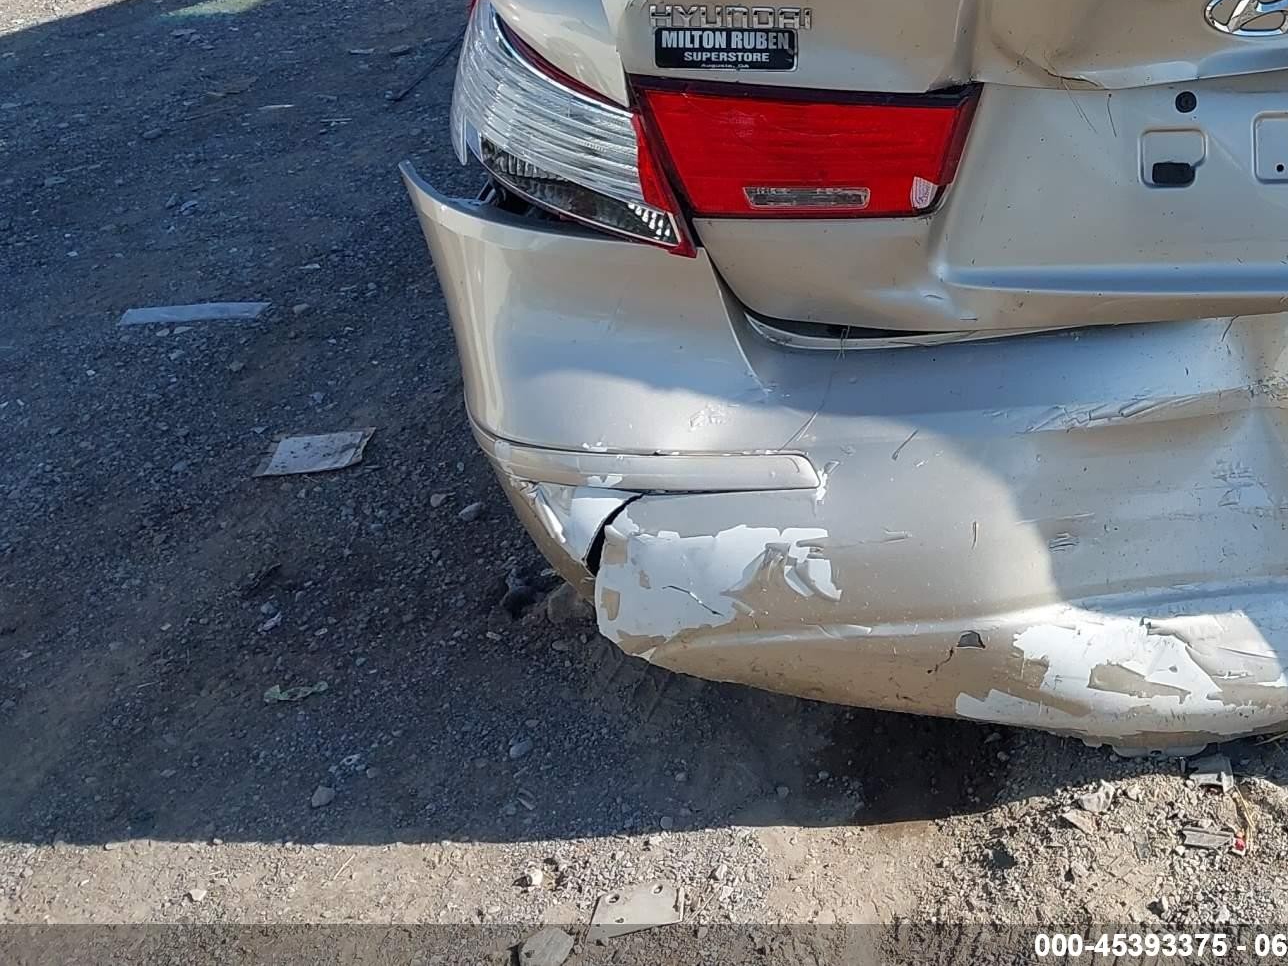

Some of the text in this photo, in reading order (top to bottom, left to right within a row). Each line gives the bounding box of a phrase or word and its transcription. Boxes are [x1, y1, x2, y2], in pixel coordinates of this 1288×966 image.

[649, 4, 812, 29] HYUNDAI
[661, 30, 789, 49] MILTON RUBEN
[684, 51, 770, 62] SUPERSTORE
